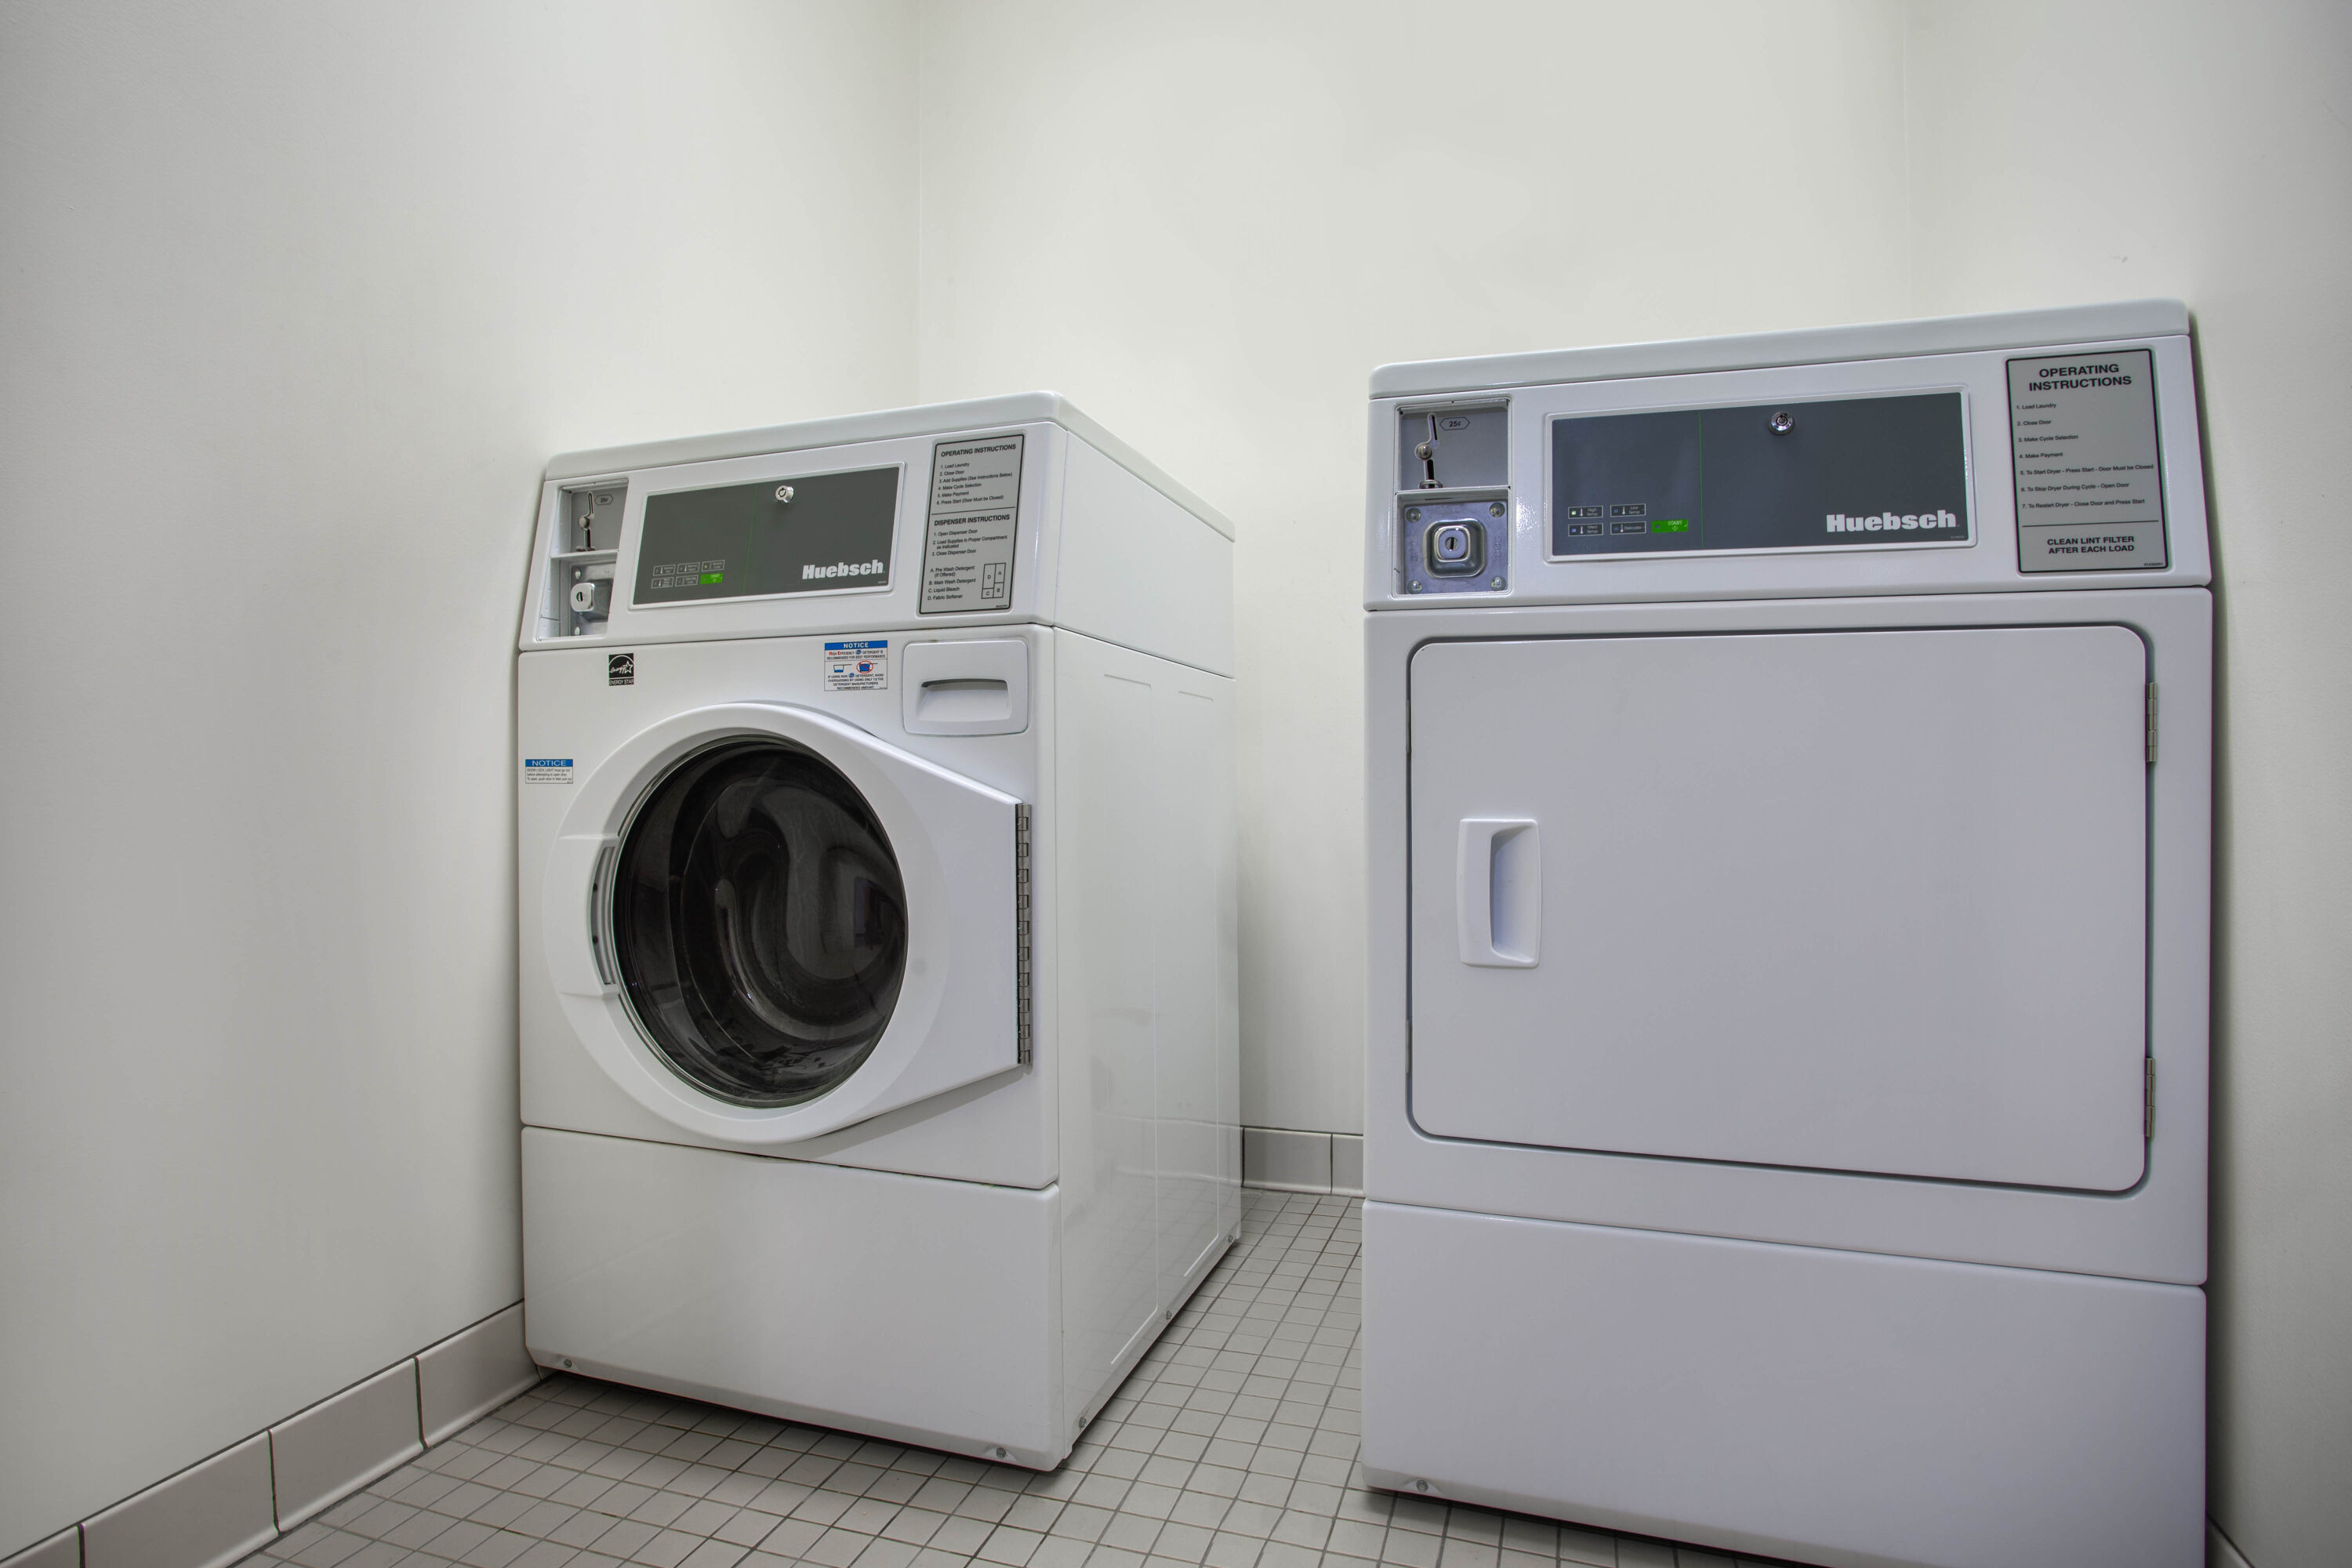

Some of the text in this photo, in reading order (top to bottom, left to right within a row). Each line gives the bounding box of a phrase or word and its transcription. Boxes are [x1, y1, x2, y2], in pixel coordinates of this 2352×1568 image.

[2039, 364, 2119, 377] OPERATING
[2029, 376, 2132, 391] INSTRUCTIONS
[941, 445, 1016, 457] OPERATING INSTRUCTIONS
[967, 514, 1010, 523] INSTRUCTIONS
[1827, 510, 1957, 532] Huebsch
[803, 560, 883, 579] Huebsch
